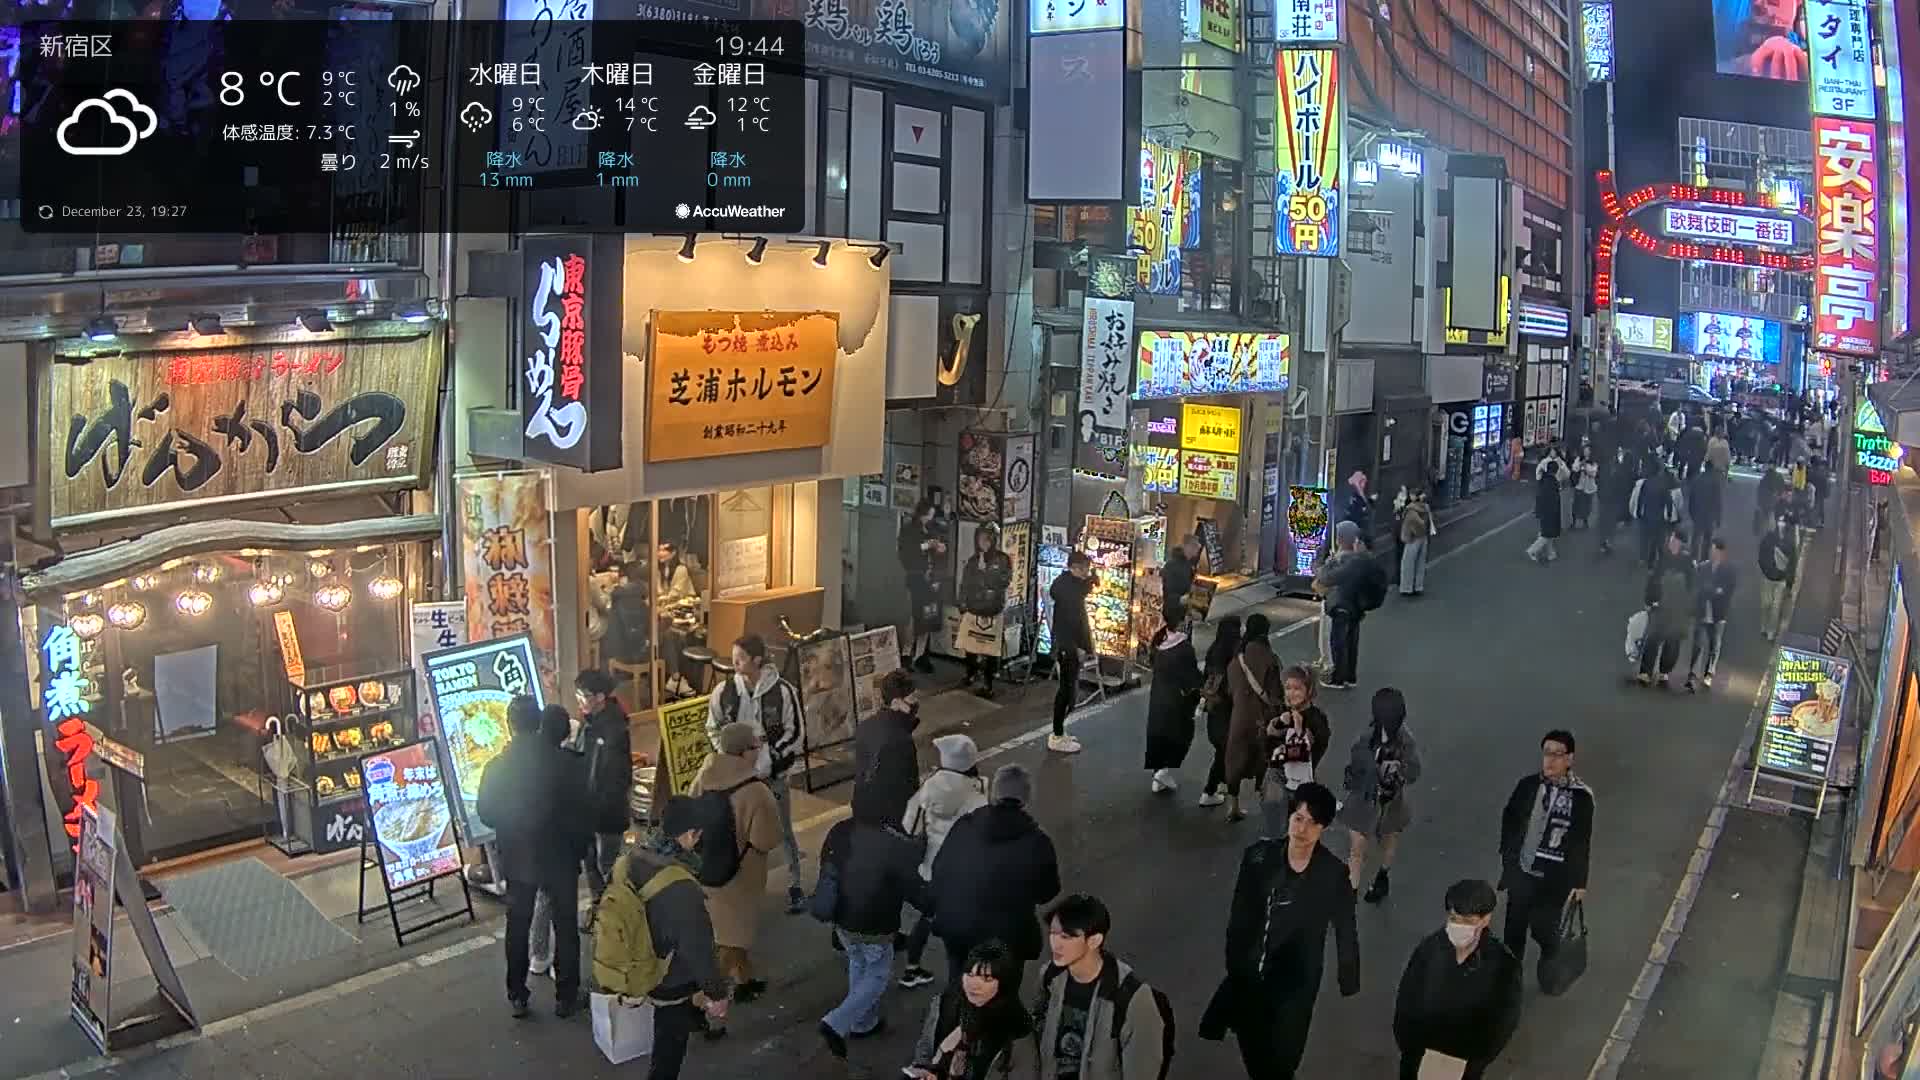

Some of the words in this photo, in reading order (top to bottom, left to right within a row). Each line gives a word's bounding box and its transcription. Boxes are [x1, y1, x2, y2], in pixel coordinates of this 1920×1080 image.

[1588, 63, 1610, 79] 7F
[1832, 97, 1855, 111] 3F
[1296, 56, 1321, 189] ハイボール
[1670, 211, 1789, 242] 歌舞伎町一番街
[1819, 126, 1875, 330] 安楽亭
[560, 254, 585, 400] 東京豚骨
[1818, 332, 1837, 347] 2F
[1098, 309, 1127, 415] お好み焼き
[668, 365, 823, 406] 芝浦ホルモン
[431, 661, 477, 683] TOKYO
[1781, 672, 1827, 683] CHEESE
[435, 675, 479, 696] RAMEN
